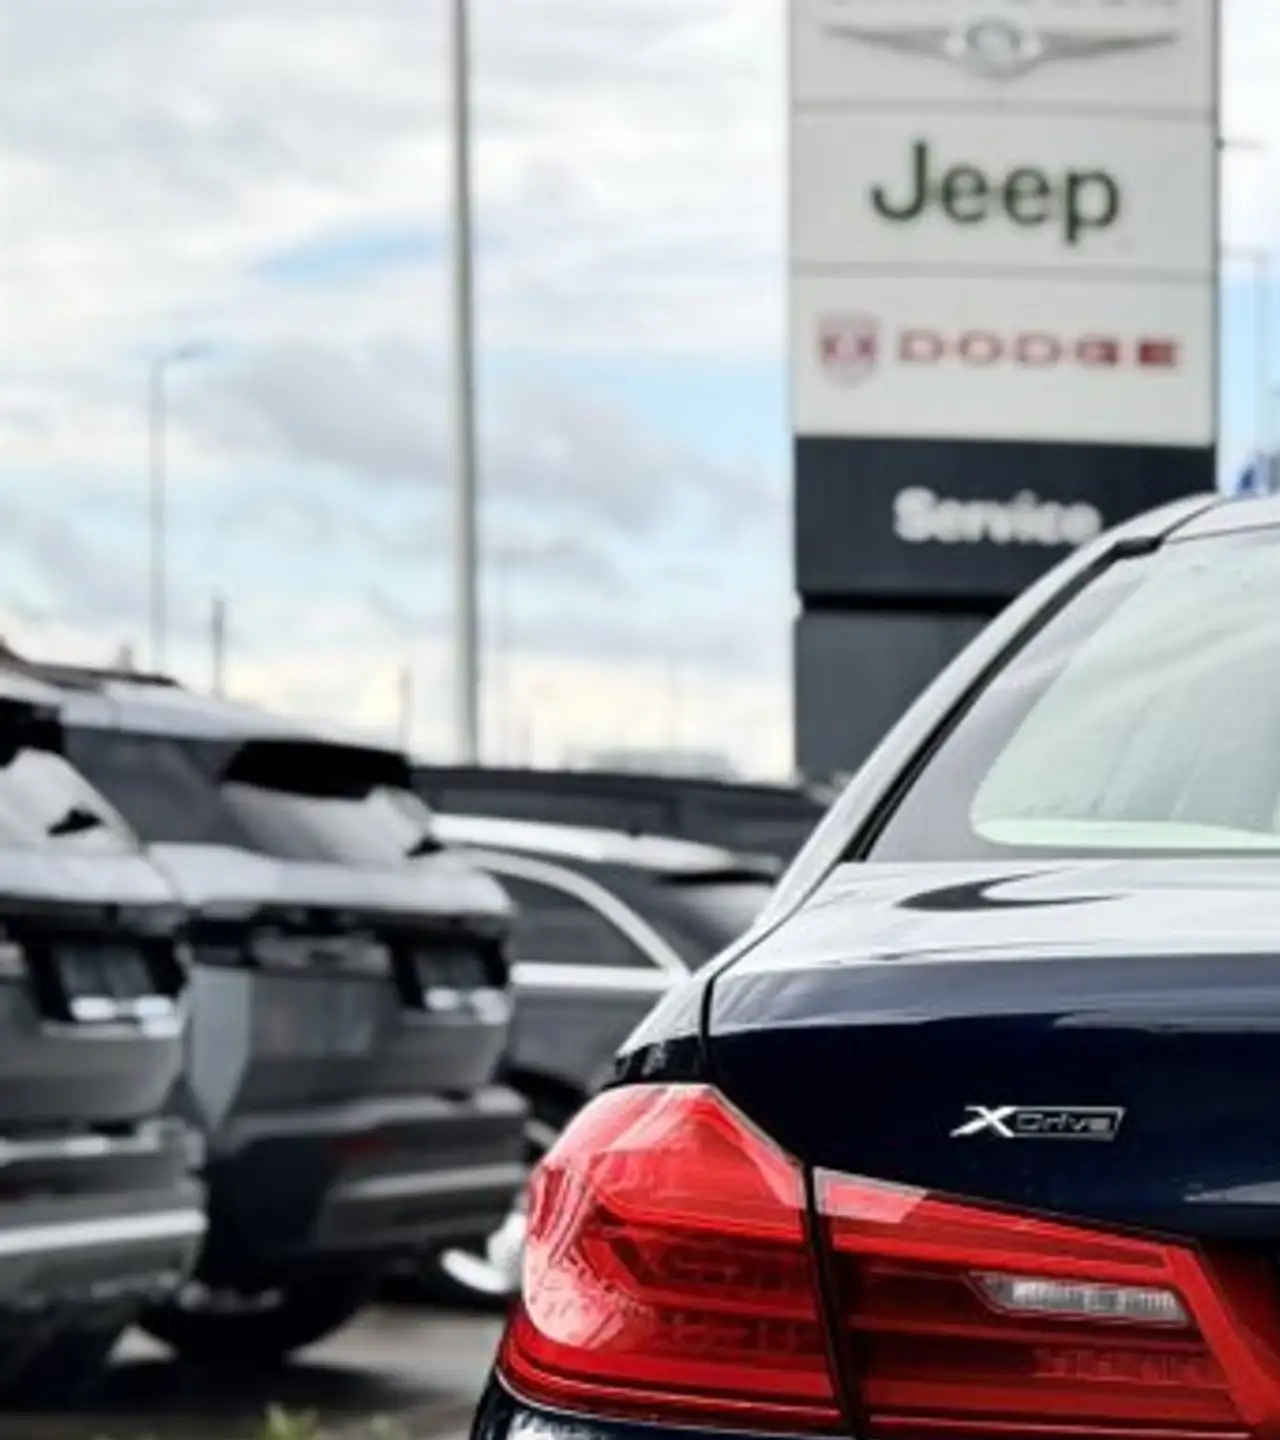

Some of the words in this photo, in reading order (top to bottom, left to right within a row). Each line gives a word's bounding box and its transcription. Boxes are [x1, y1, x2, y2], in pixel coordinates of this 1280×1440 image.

[870, 138, 1122, 246] Jeep
[898, 329, 1178, 369] DODGE
[893, 486, 1103, 548] Service
